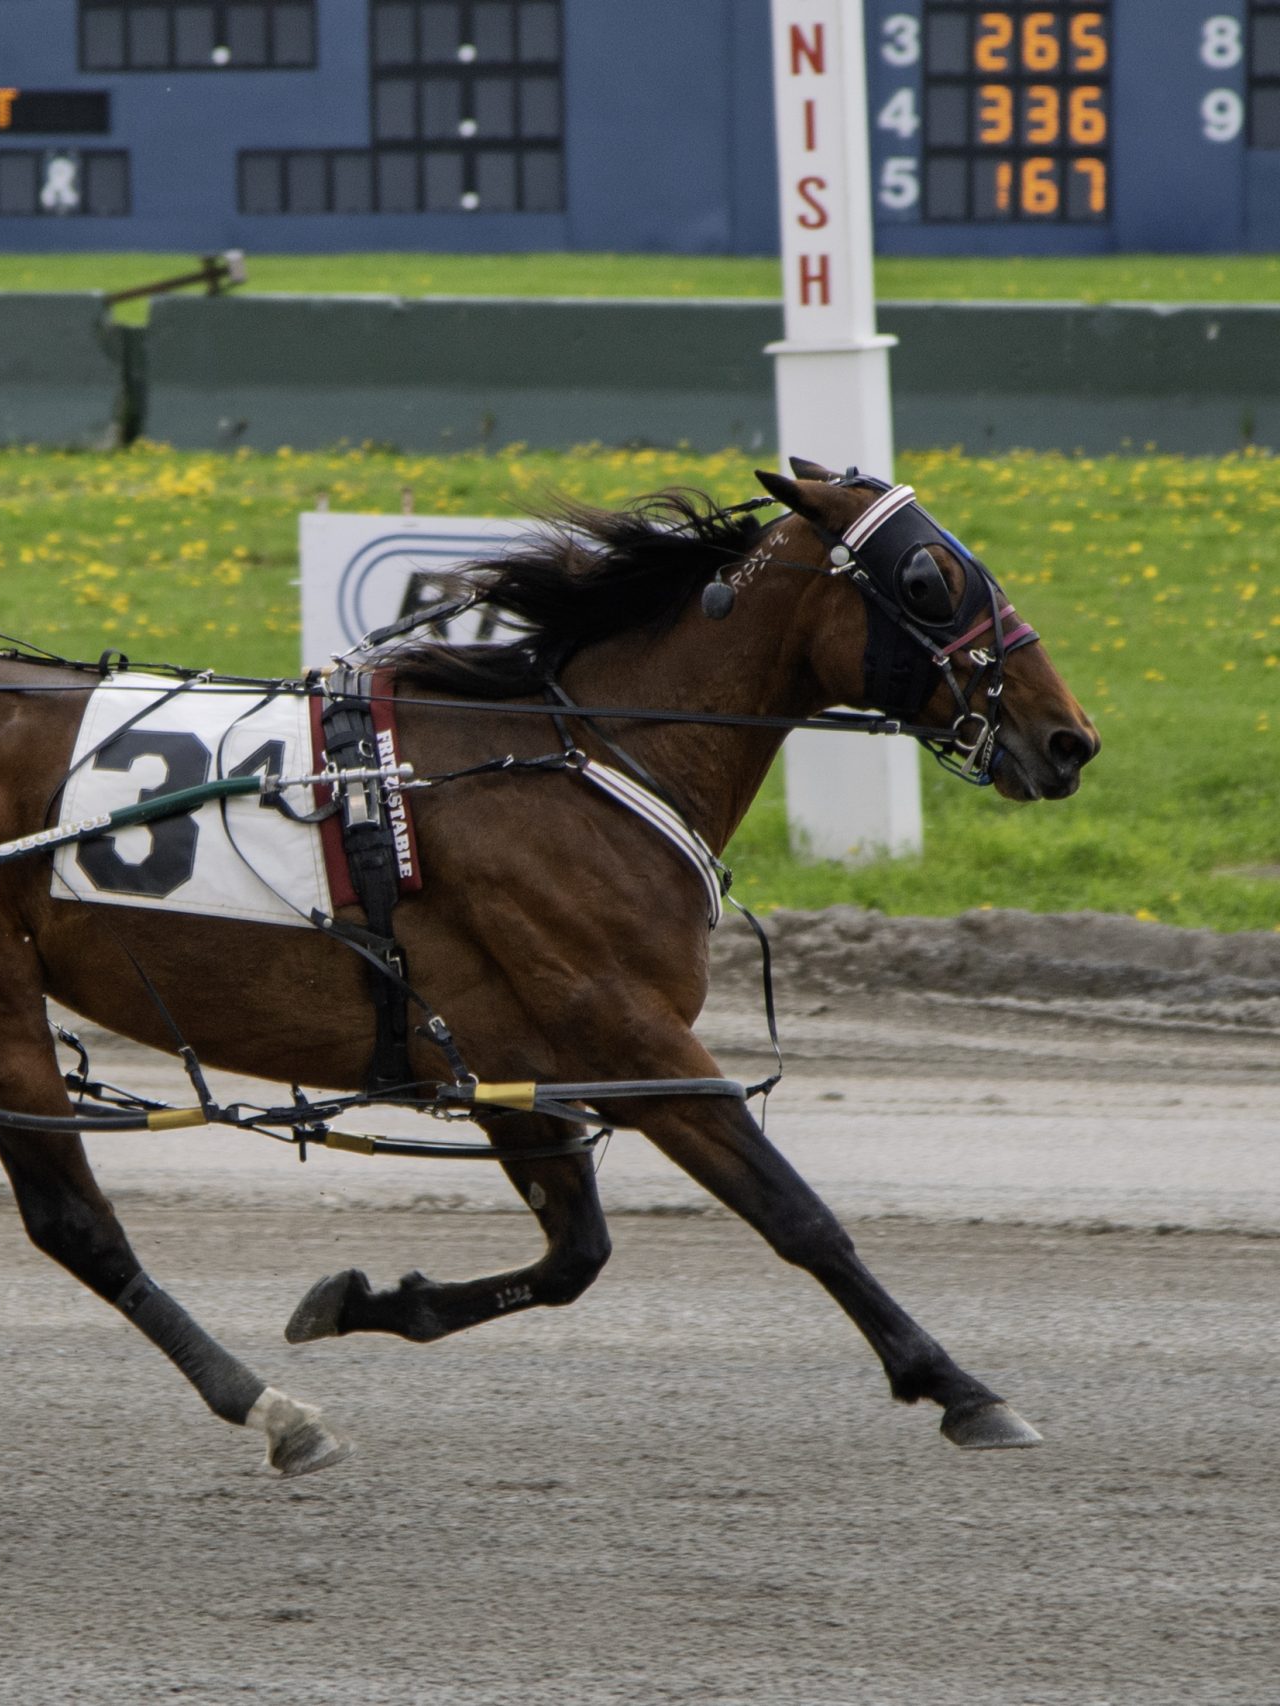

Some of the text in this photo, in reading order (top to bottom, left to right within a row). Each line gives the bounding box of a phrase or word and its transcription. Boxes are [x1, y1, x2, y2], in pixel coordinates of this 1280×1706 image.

[881, 14, 920, 66] 3
[975, 12, 1107, 72] 265
[1200, 15, 1242, 69] 8
[878, 88, 919, 138] 4
[979, 84, 1107, 145] 336
[1200, 88, 1243, 142] 9
[880, 157, 919, 209] 5
[995, 157, 1107, 213] 167
[77, 729, 212, 898] 3
[387, 792, 413, 879] STABLE
